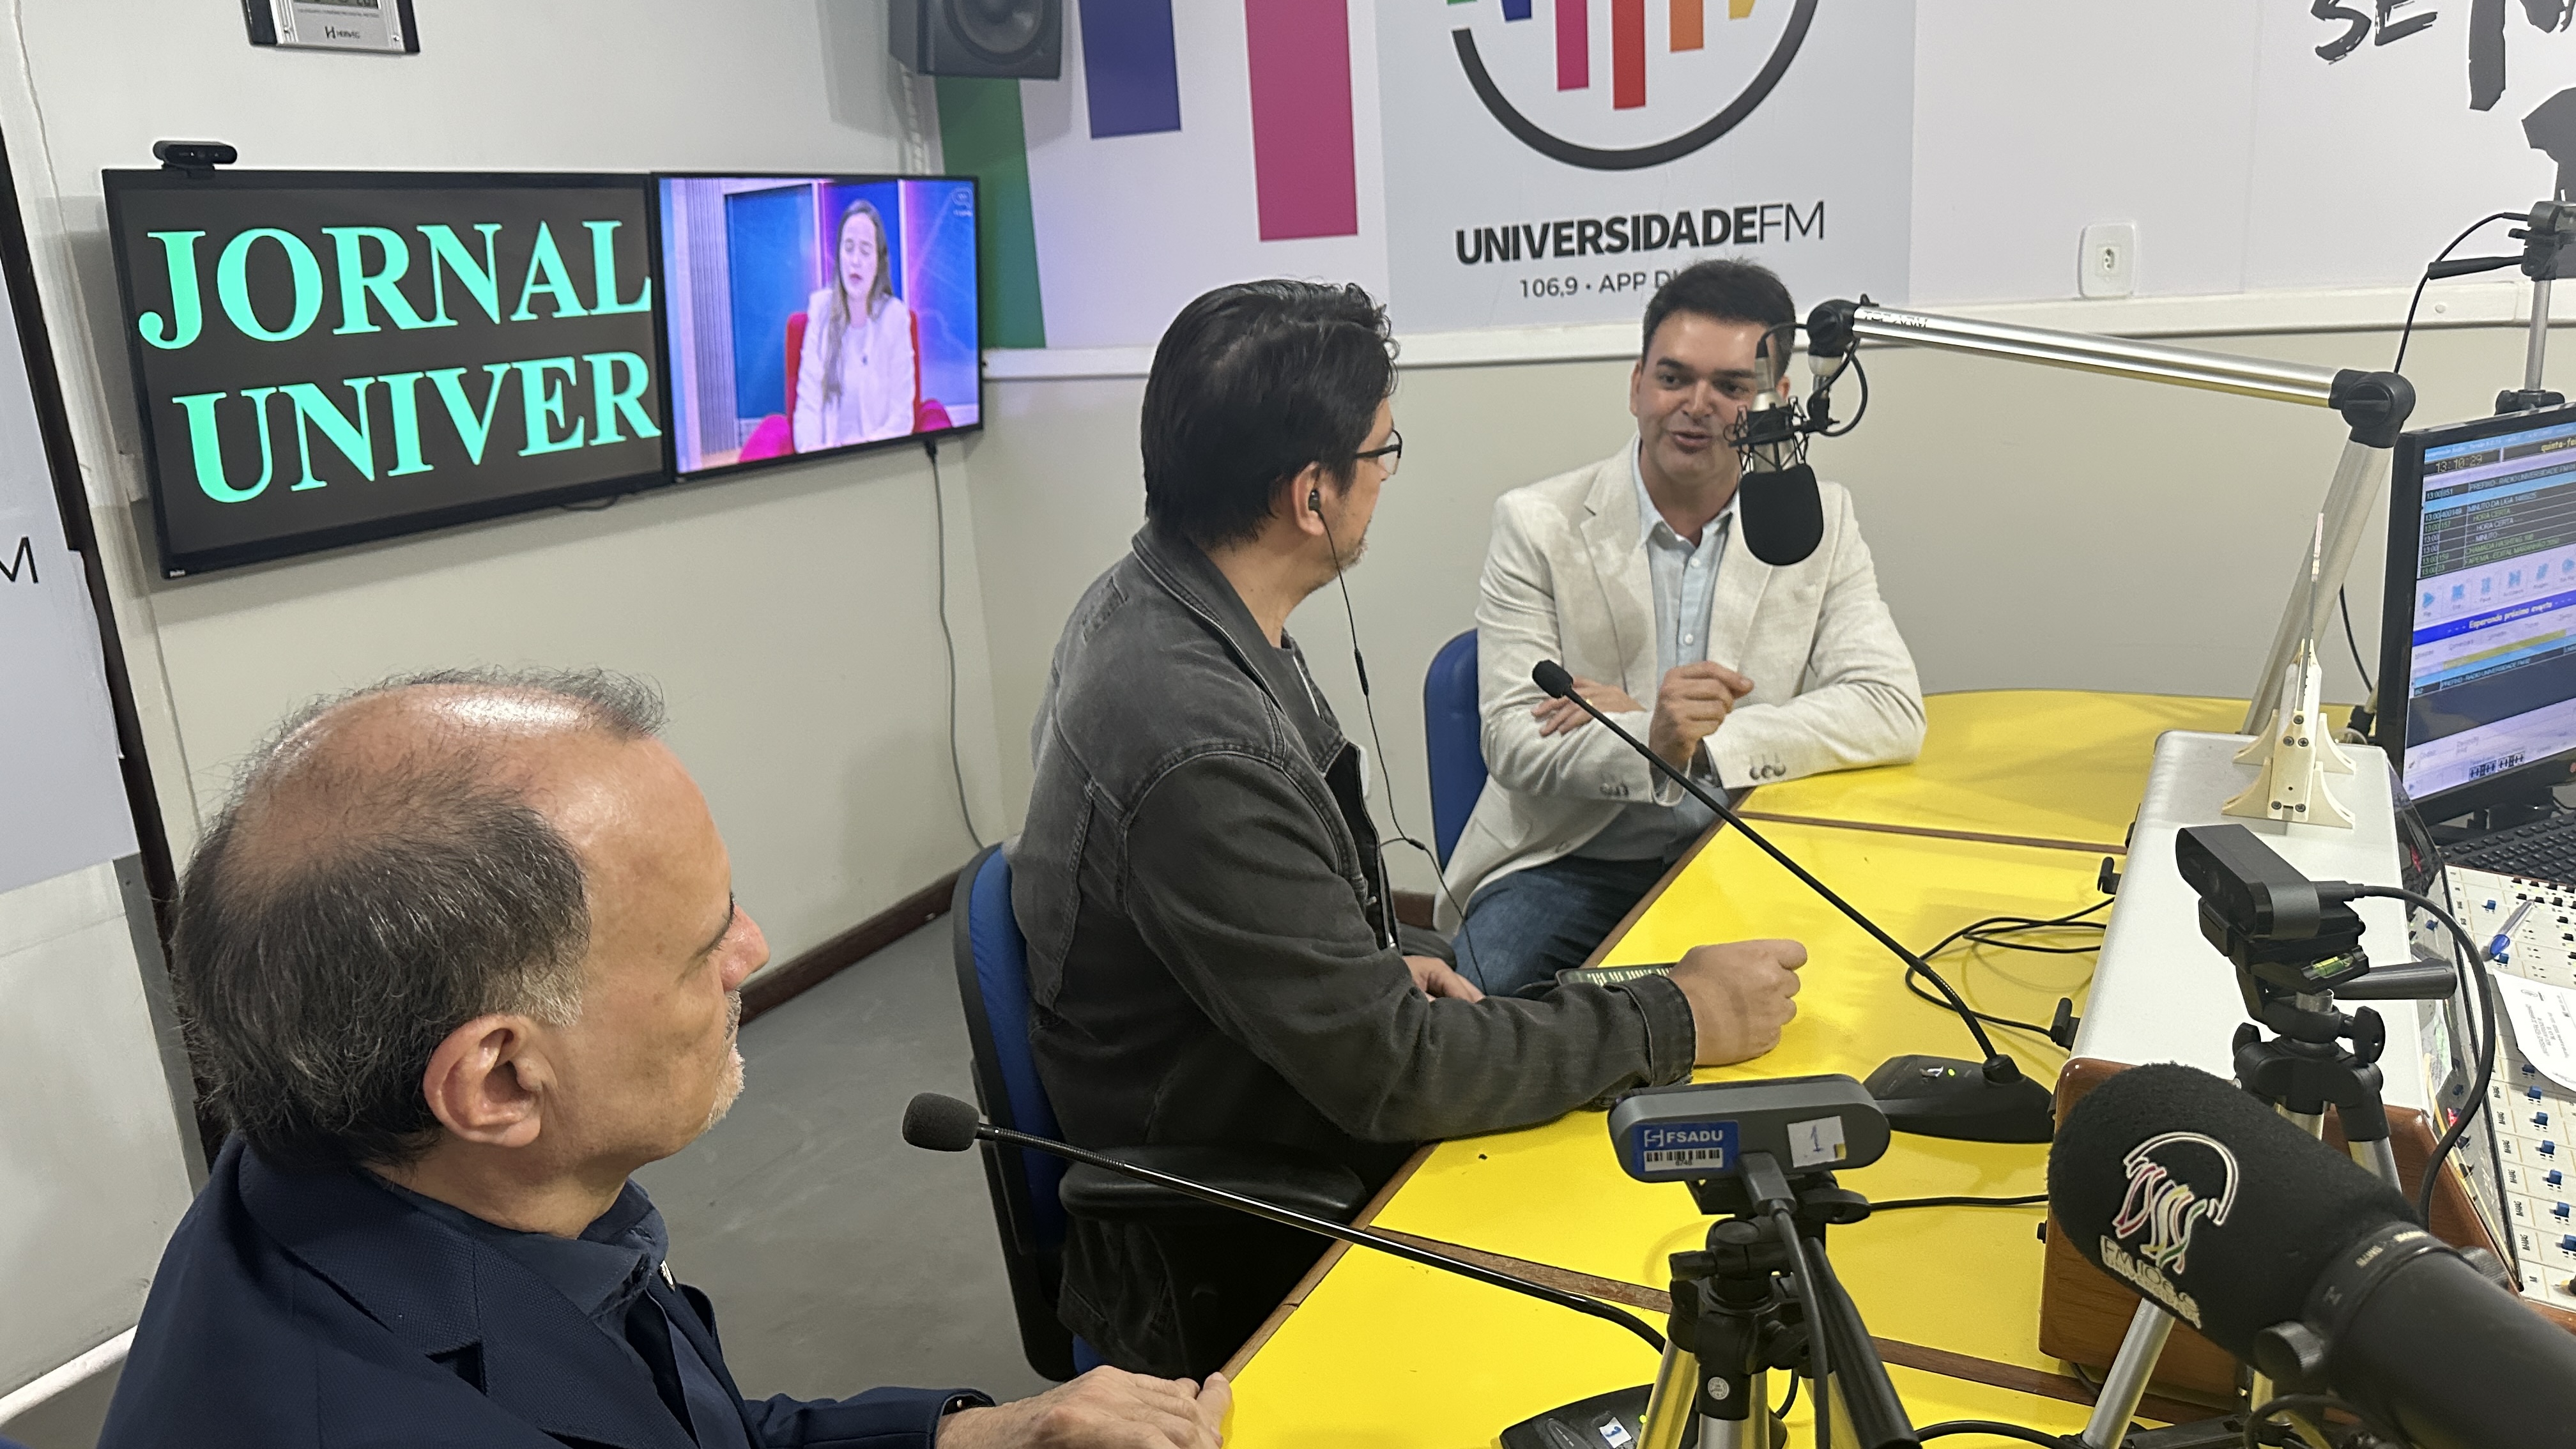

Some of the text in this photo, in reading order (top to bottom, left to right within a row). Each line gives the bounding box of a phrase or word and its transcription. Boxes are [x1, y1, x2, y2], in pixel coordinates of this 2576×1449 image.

[139, 220, 652, 349] JORNAL
[1598, 271, 1646, 293] APP
[172, 351, 662, 503] UNIVER
[1666, 1130, 1724, 1144] FSADU
